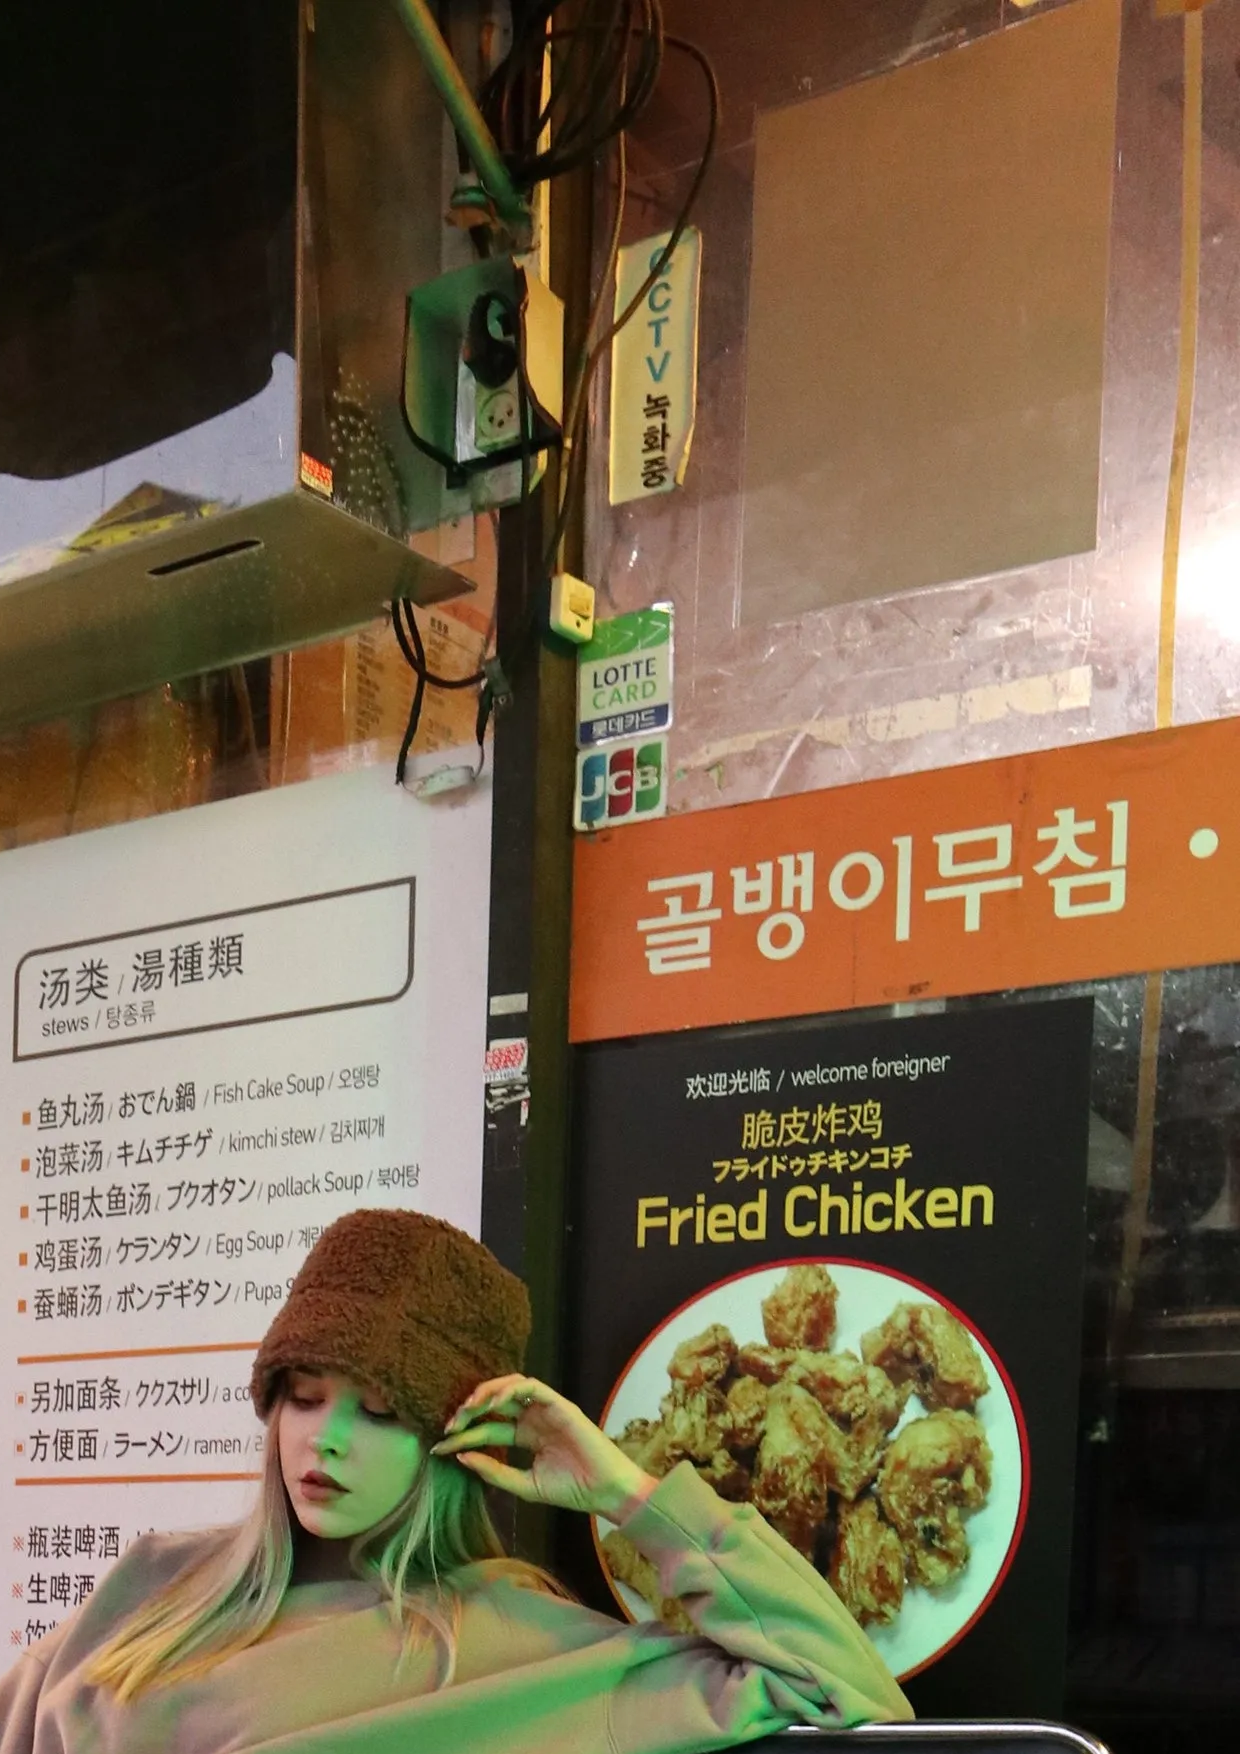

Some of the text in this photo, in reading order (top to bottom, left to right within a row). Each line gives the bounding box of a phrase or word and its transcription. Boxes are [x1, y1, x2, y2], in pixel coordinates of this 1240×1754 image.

[646, 246, 674, 383] CCTV
[642, 394, 670, 488] 녹화중
[592, 679, 657, 710] CARD
[593, 657, 657, 689] LOTTE
[591, 709, 656, 739] 롯데카드
[580, 766, 660, 800] JCB
[637, 800, 1129, 975] 골뱅이무침
[39, 933, 244, 1010] 汤类 湯種類
[42, 1000, 156, 1037] stews 탕종류
[686, 1052, 951, 1099] 欢迎光临 welcome foreigner
[37, 1064, 380, 1131] 鱼丸汤 おでん鍋 Fish Cake Soup 오뎅탕
[741, 1099, 883, 1150] 脆皮炸鸡
[36, 1115, 385, 1179] 泡菜汤 キムチチゲ kimchi stew 김치찌개
[712, 1145, 913, 1183] フライドゥチキンコチ
[36, 1164, 420, 1226] 干明太鱼汤 pollack Soup 북어탕
[637, 1179, 994, 1248] Fried Chicken
[34, 1235, 102, 1273] 鸡蛋汤
[116, 1231, 200, 1265] ケランタン
[216, 1233, 243, 1259] Egg
[246, 1230, 284, 1254] Soup
[34, 1283, 102, 1321] 蚕蛹汤
[244, 1281, 282, 1303] Pupa
[31, 1376, 121, 1413] 另加面条
[135, 1377, 210, 1408] ククスサリ
[30, 1428, 98, 1462] 方便面
[114, 1430, 184, 1458] ラーメン
[194, 1435, 241, 1455] ramen
[27, 1524, 120, 1560] 瓶装啤酒
